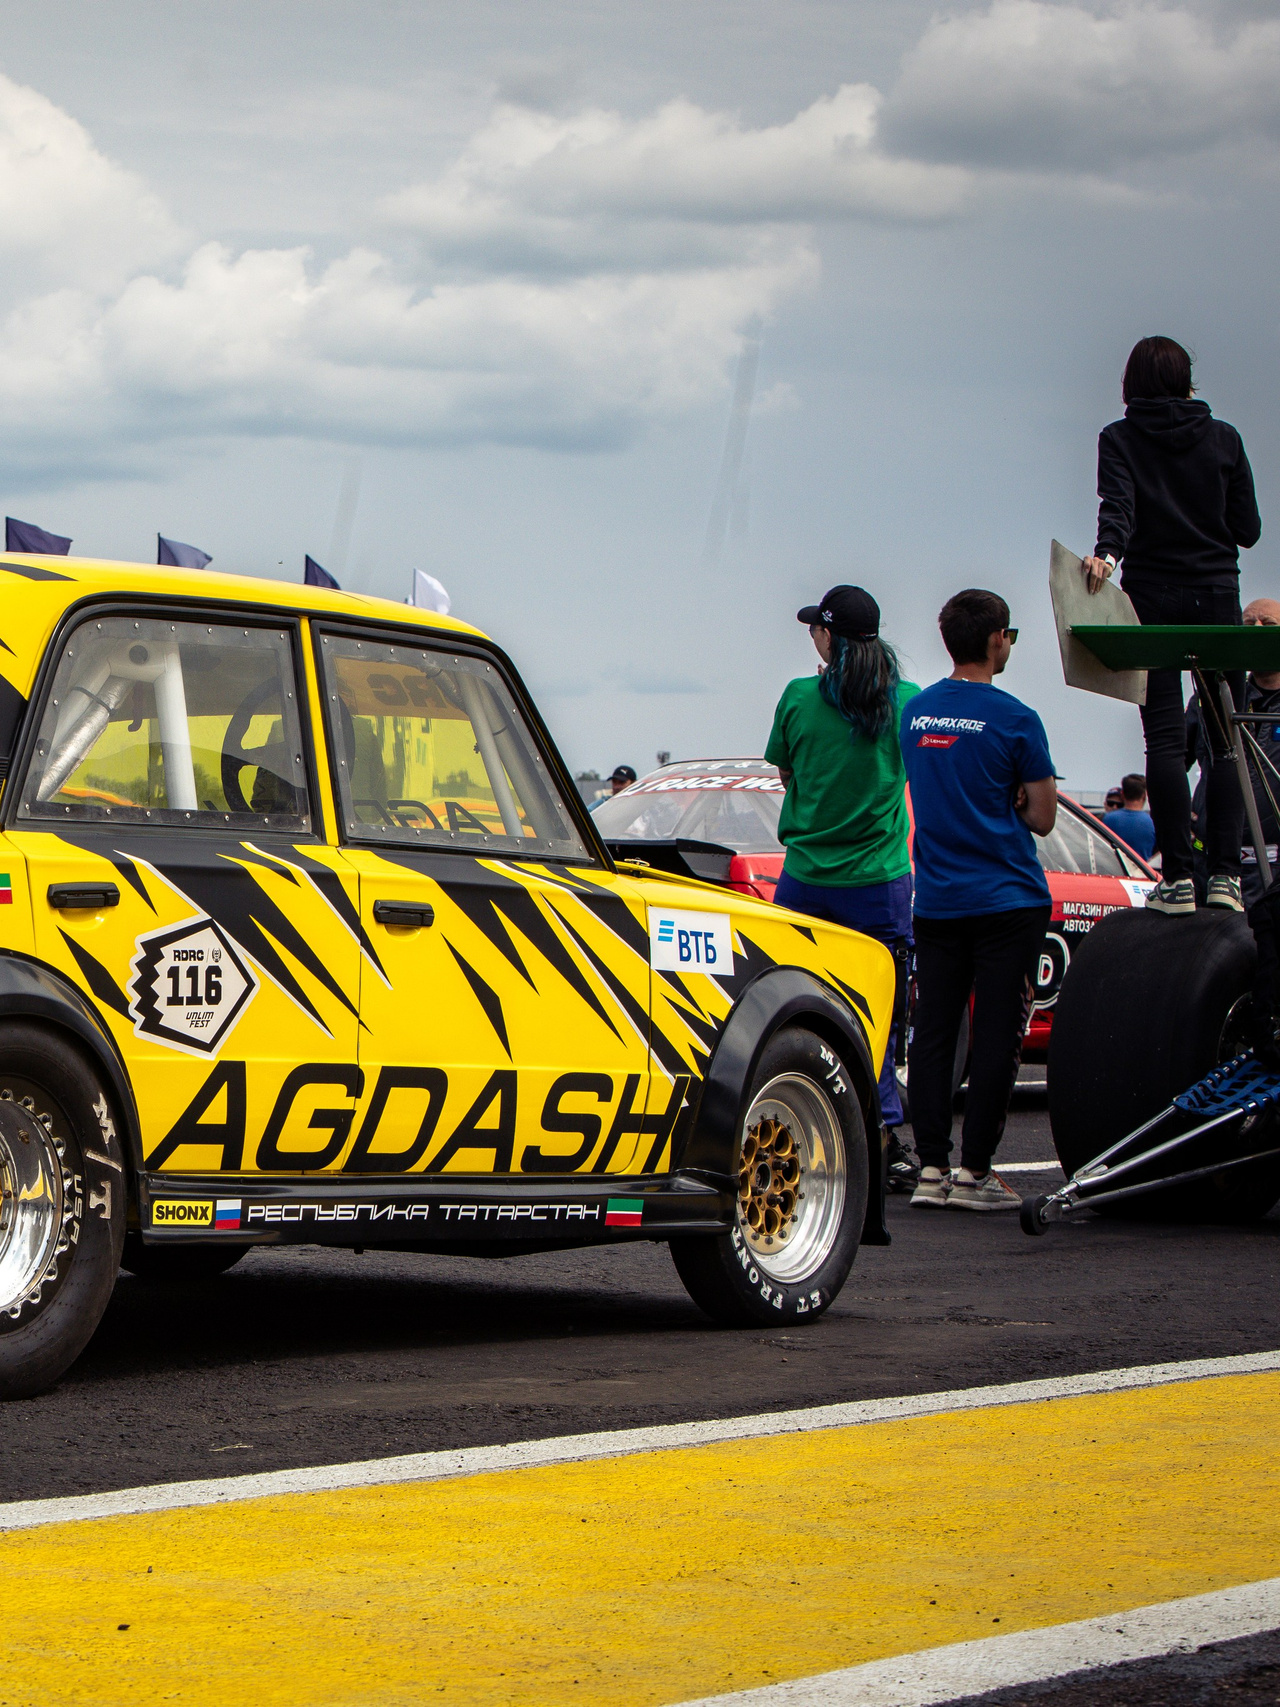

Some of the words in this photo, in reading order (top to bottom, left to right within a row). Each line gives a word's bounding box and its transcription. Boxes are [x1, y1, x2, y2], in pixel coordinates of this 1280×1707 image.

[645, 775, 744, 792] RACE
[1062, 902, 1102, 917] МАГАЗИН
[173, 949, 204, 961] RDRC
[677, 929, 718, 965] ВТБ
[166, 965, 223, 1007] 116
[189, 1020, 211, 1029] FEST
[143, 1059, 692, 1175] AGDASH
[70, 1174, 82, 1246] USA
[155, 1203, 211, 1222] SHONX
[247, 1204, 429, 1222] РЕСПУБЛИКА
[439, 1203, 601, 1222] ТАТАРСТАН
